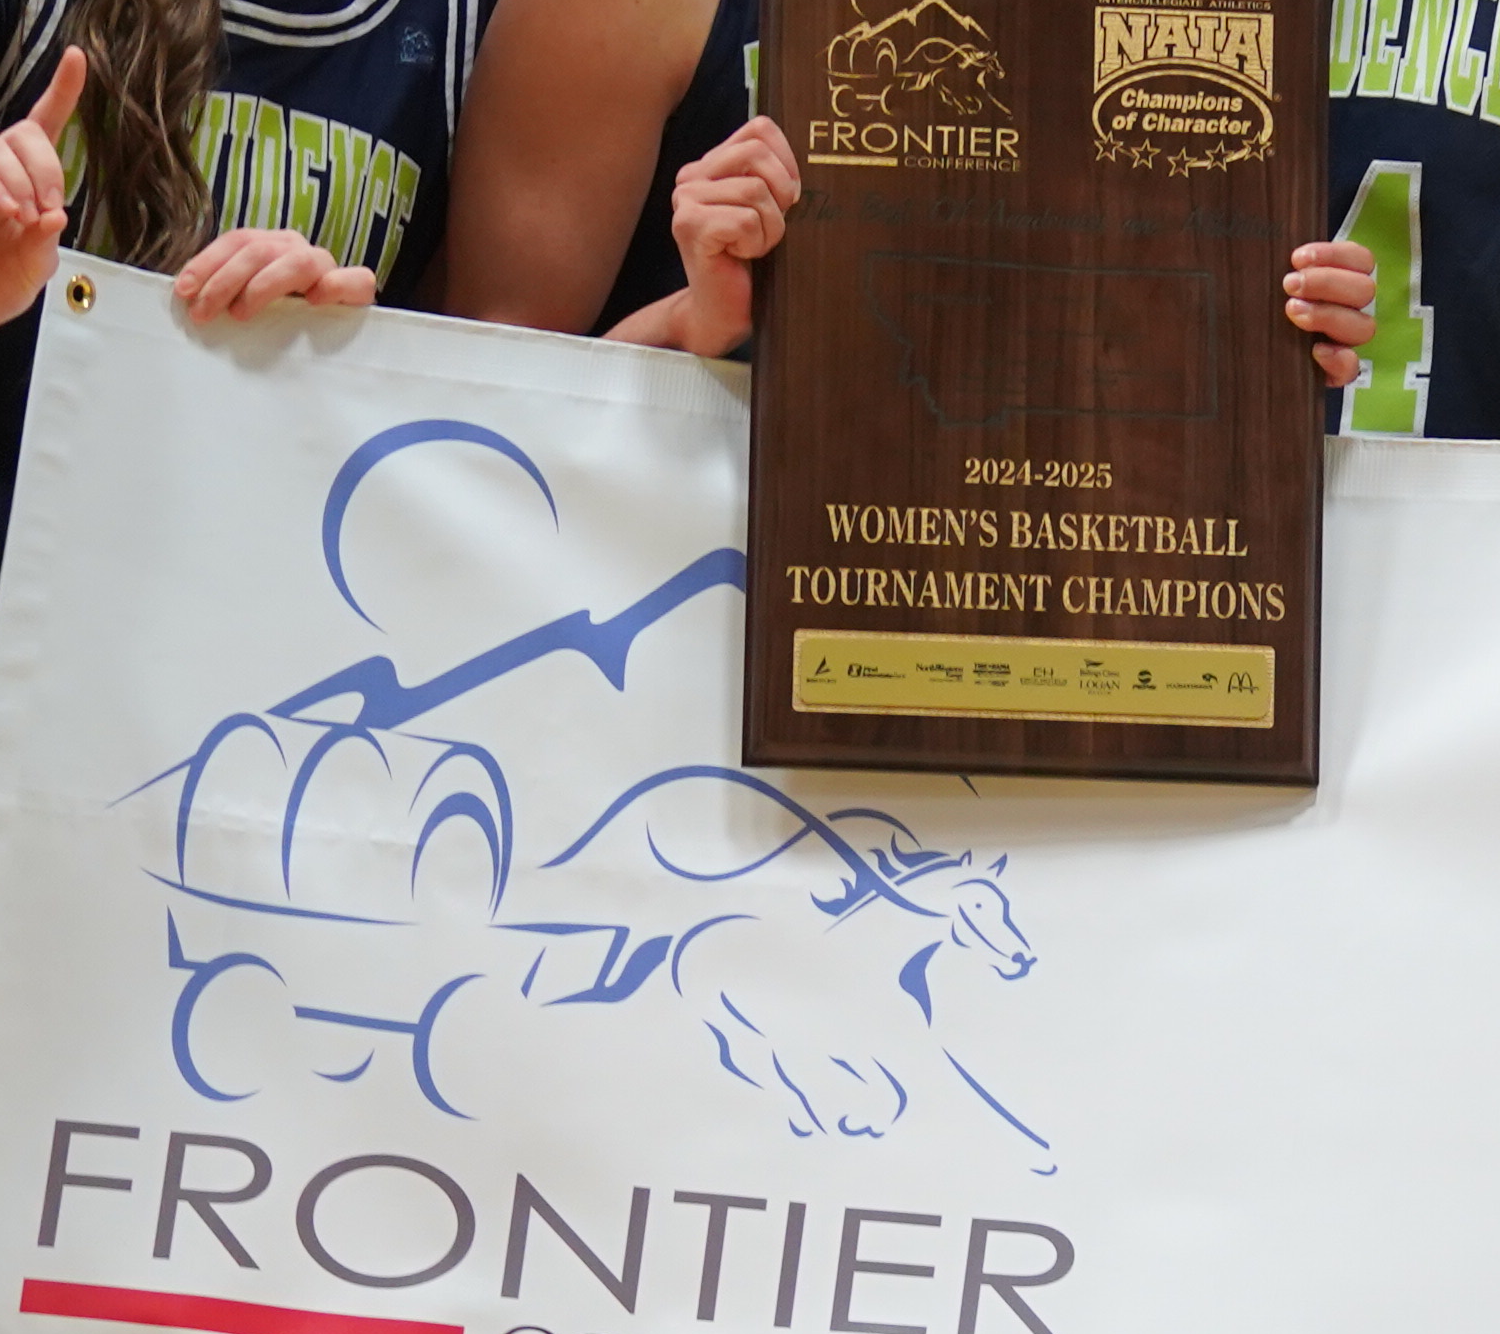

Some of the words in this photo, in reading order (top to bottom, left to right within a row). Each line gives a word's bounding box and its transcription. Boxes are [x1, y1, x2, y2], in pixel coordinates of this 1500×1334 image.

[1209, 0, 1272, 10] ATHLETICS
[1098, 12, 1268, 88] NAIA
[1120, 88, 1243, 113] Champions
[809, 120, 1020, 158] FRONTIER
[1111, 111, 1139, 131] of
[1141, 113, 1252, 135] Character
[904, 157, 1022, 172] CONFERENCE
[964, 457, 1114, 489] 2024-2025
[826, 503, 999, 548] WOMEN'S
[1010, 510, 1249, 557] BASKETBALL
[786, 566, 1052, 612] TOURNAMENT
[1062, 575, 1286, 622] CHAMPIONS
